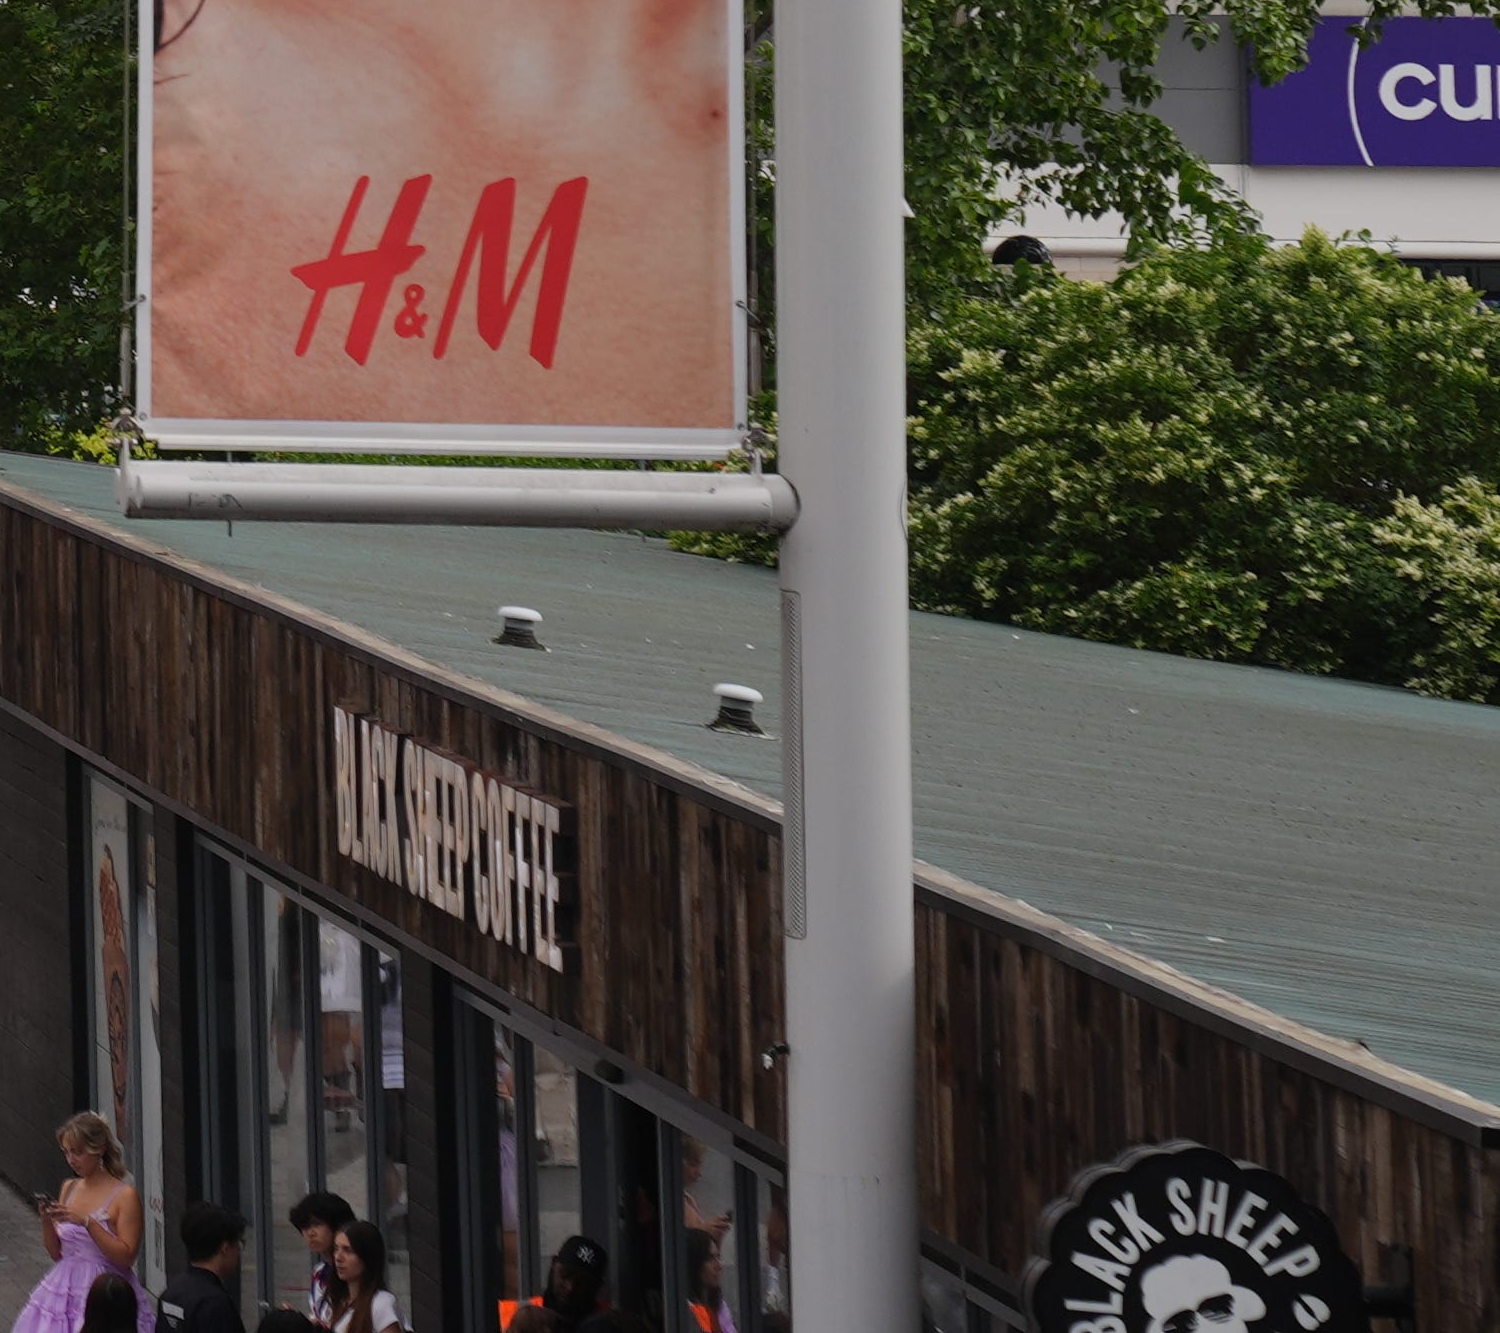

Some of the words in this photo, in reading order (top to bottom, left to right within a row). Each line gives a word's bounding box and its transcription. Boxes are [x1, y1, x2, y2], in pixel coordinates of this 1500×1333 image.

[1378, 62, 1500, 121] cu
[289, 173, 589, 370] H&M
[333, 705, 402, 887] BLACK
[403, 738, 469, 920] SHEEP
[471, 772, 563, 973] COFFEE
[1166, 1176, 1322, 1278] SHEEP
